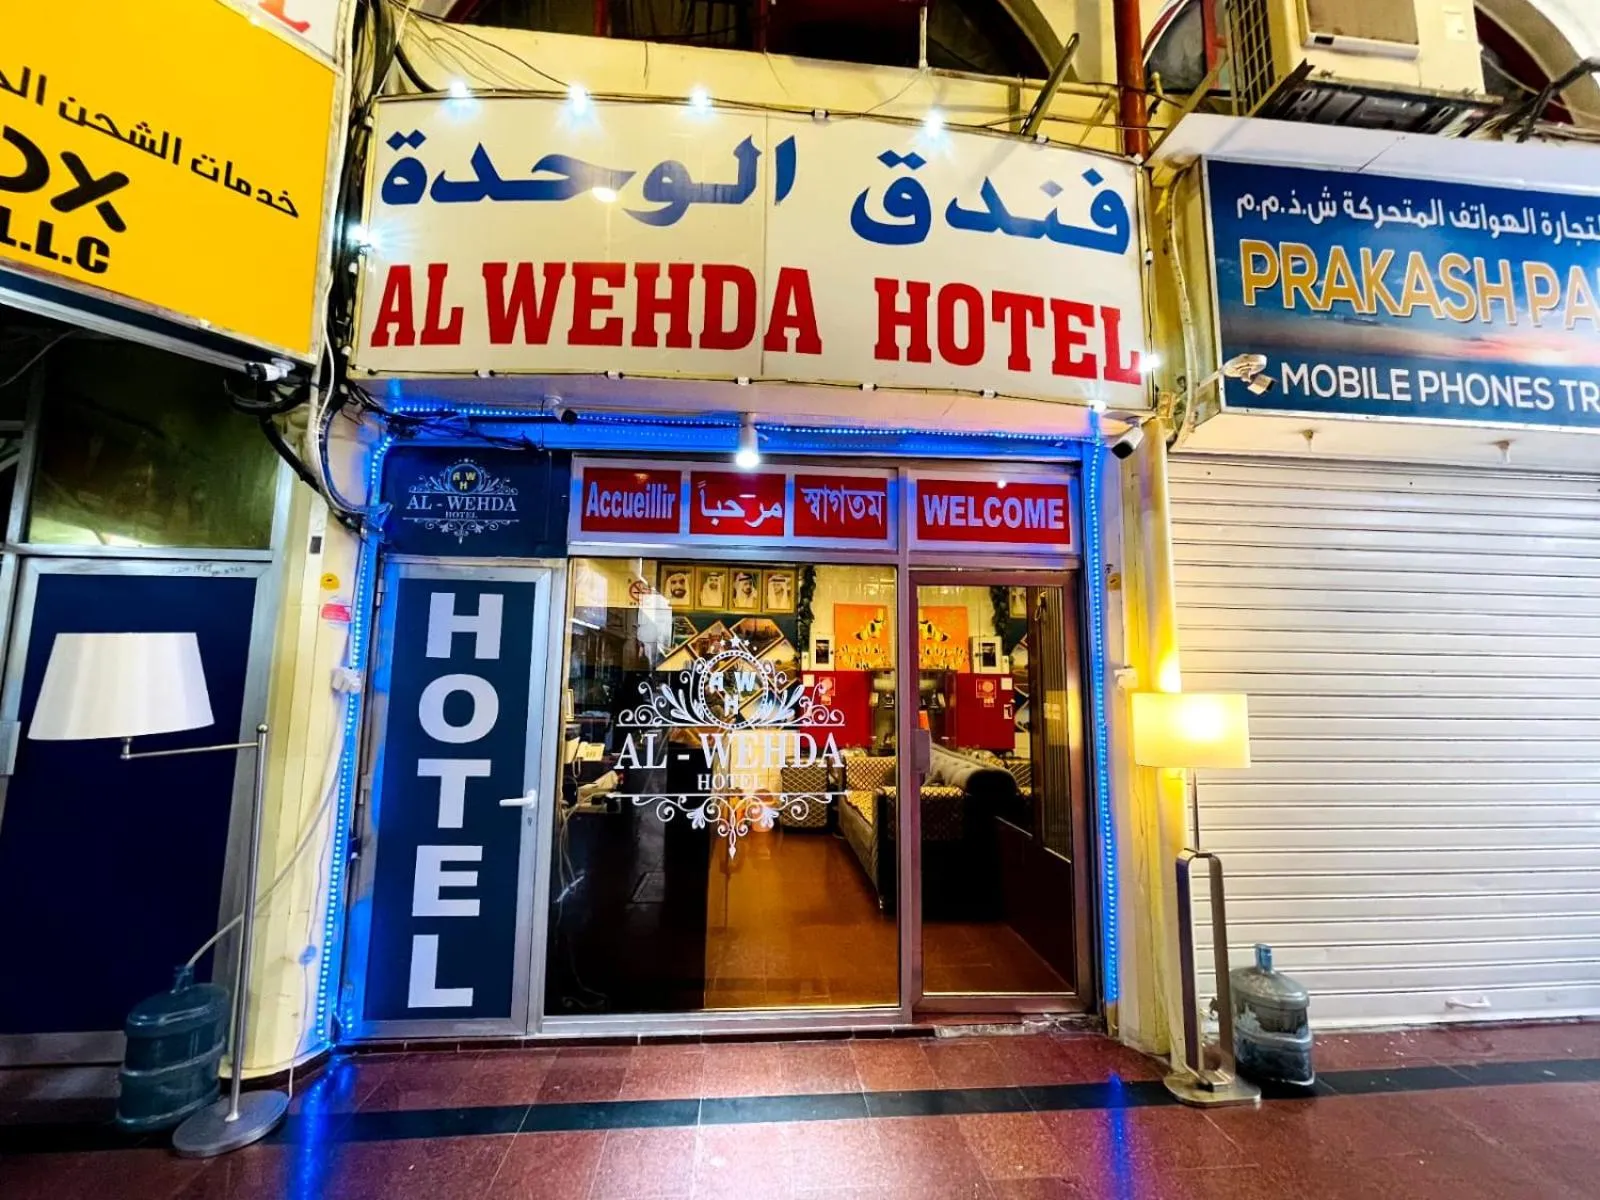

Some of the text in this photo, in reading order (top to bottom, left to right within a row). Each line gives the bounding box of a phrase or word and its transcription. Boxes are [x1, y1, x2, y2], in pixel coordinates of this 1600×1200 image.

[0, 66, 299, 218] خدمات الشحن ال
[381, 129, 1131, 255] فندق الوحدة
[1343, 191, 1445, 229] المتحركة
[1449, 203, 1537, 240] الهواتف
[1239, 239, 1600, 331] PRAKASH PA
[370, 262, 1143, 386] AL WEHDA HOTEL
[1280, 362, 1412, 402] MOBILE
[1418, 370, 1555, 411] PHONES
[446, 495, 518, 512] WEHDA
[586, 481, 676, 521] Accueillir
[923, 494, 1065, 530] WELCOME
[613, 732, 667, 769] AL
[698, 732, 845, 769] WEHDA
[407, 592, 504, 1008] HOTEL
